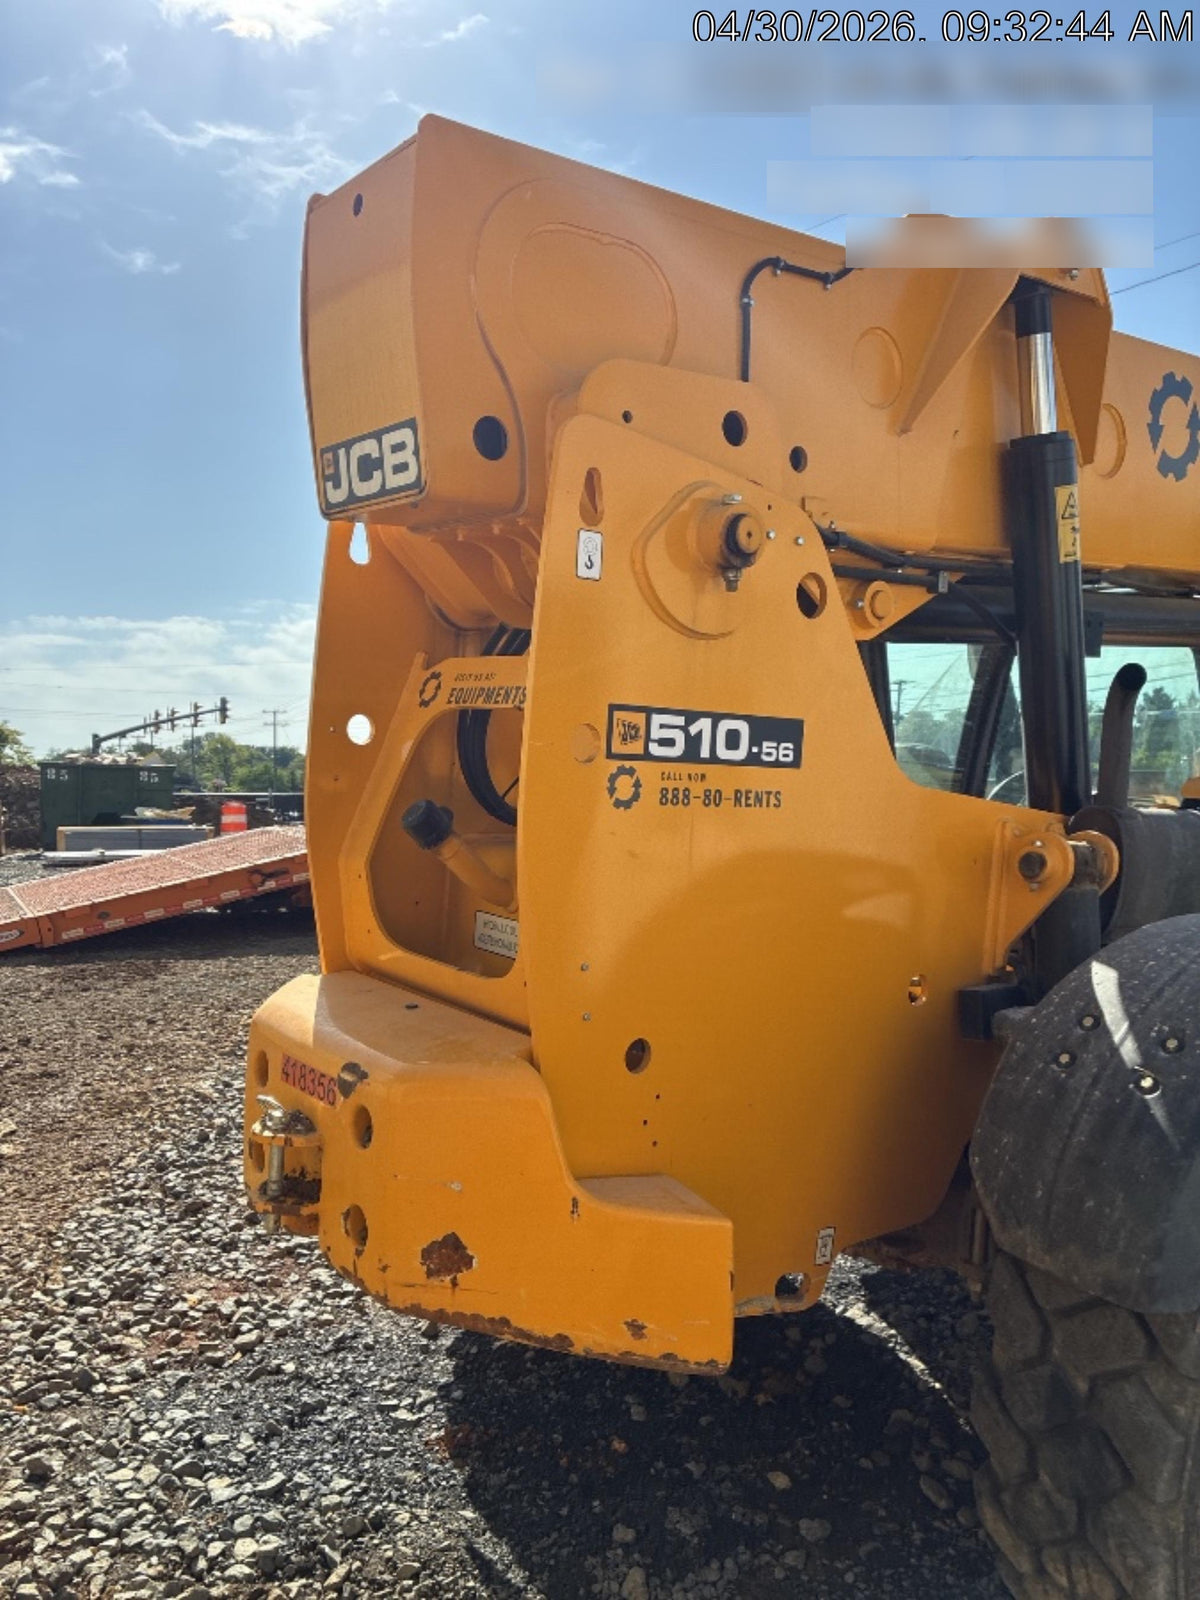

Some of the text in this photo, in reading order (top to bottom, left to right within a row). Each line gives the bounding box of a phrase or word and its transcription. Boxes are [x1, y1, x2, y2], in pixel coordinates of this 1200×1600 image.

[324, 427, 419, 504] JCB
[660, 771, 707, 782] CALL NOW
[659, 787, 782, 809] 888-80-RENTS
[281, 1056, 337, 1106] 418356
